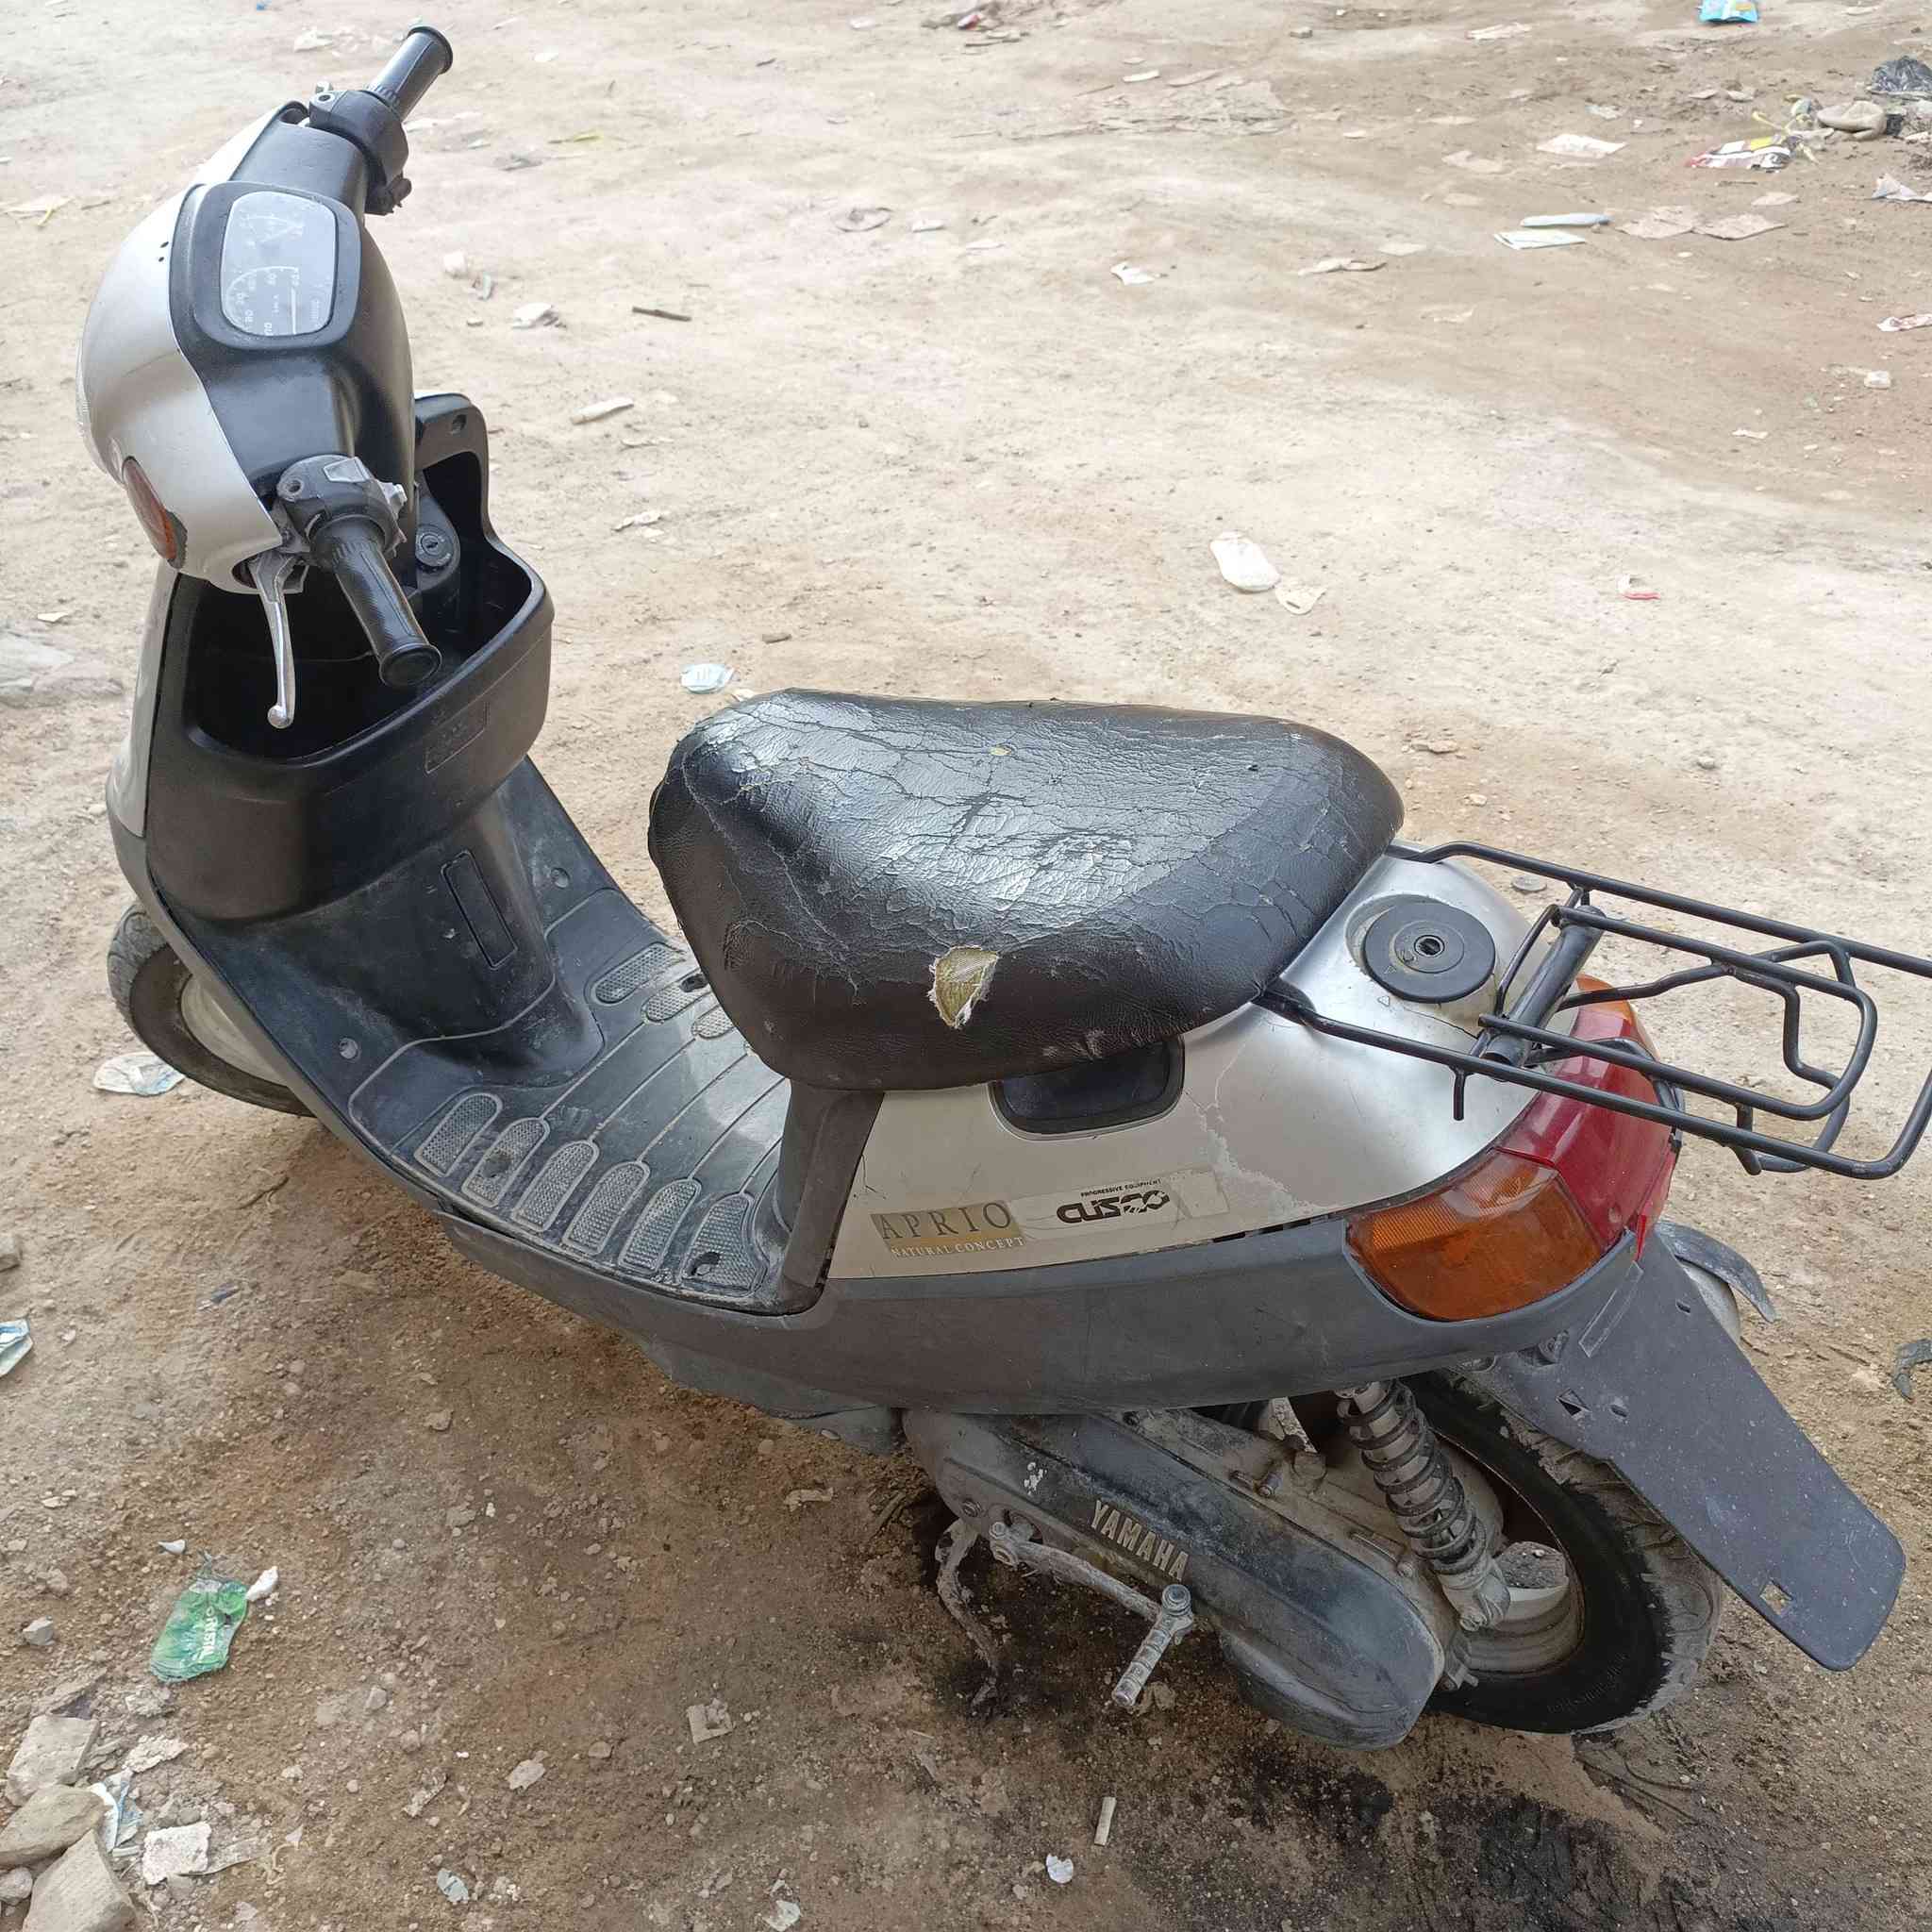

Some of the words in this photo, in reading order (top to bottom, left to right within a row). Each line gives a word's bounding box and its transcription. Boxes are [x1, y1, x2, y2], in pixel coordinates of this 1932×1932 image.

[880, 1202, 1011, 1240] APRIO
[891, 1244, 954, 1258] NATURAL
[954, 1236, 1024, 1254] CONCEPT
[1091, 1500, 1189, 1580] YAMAHA
